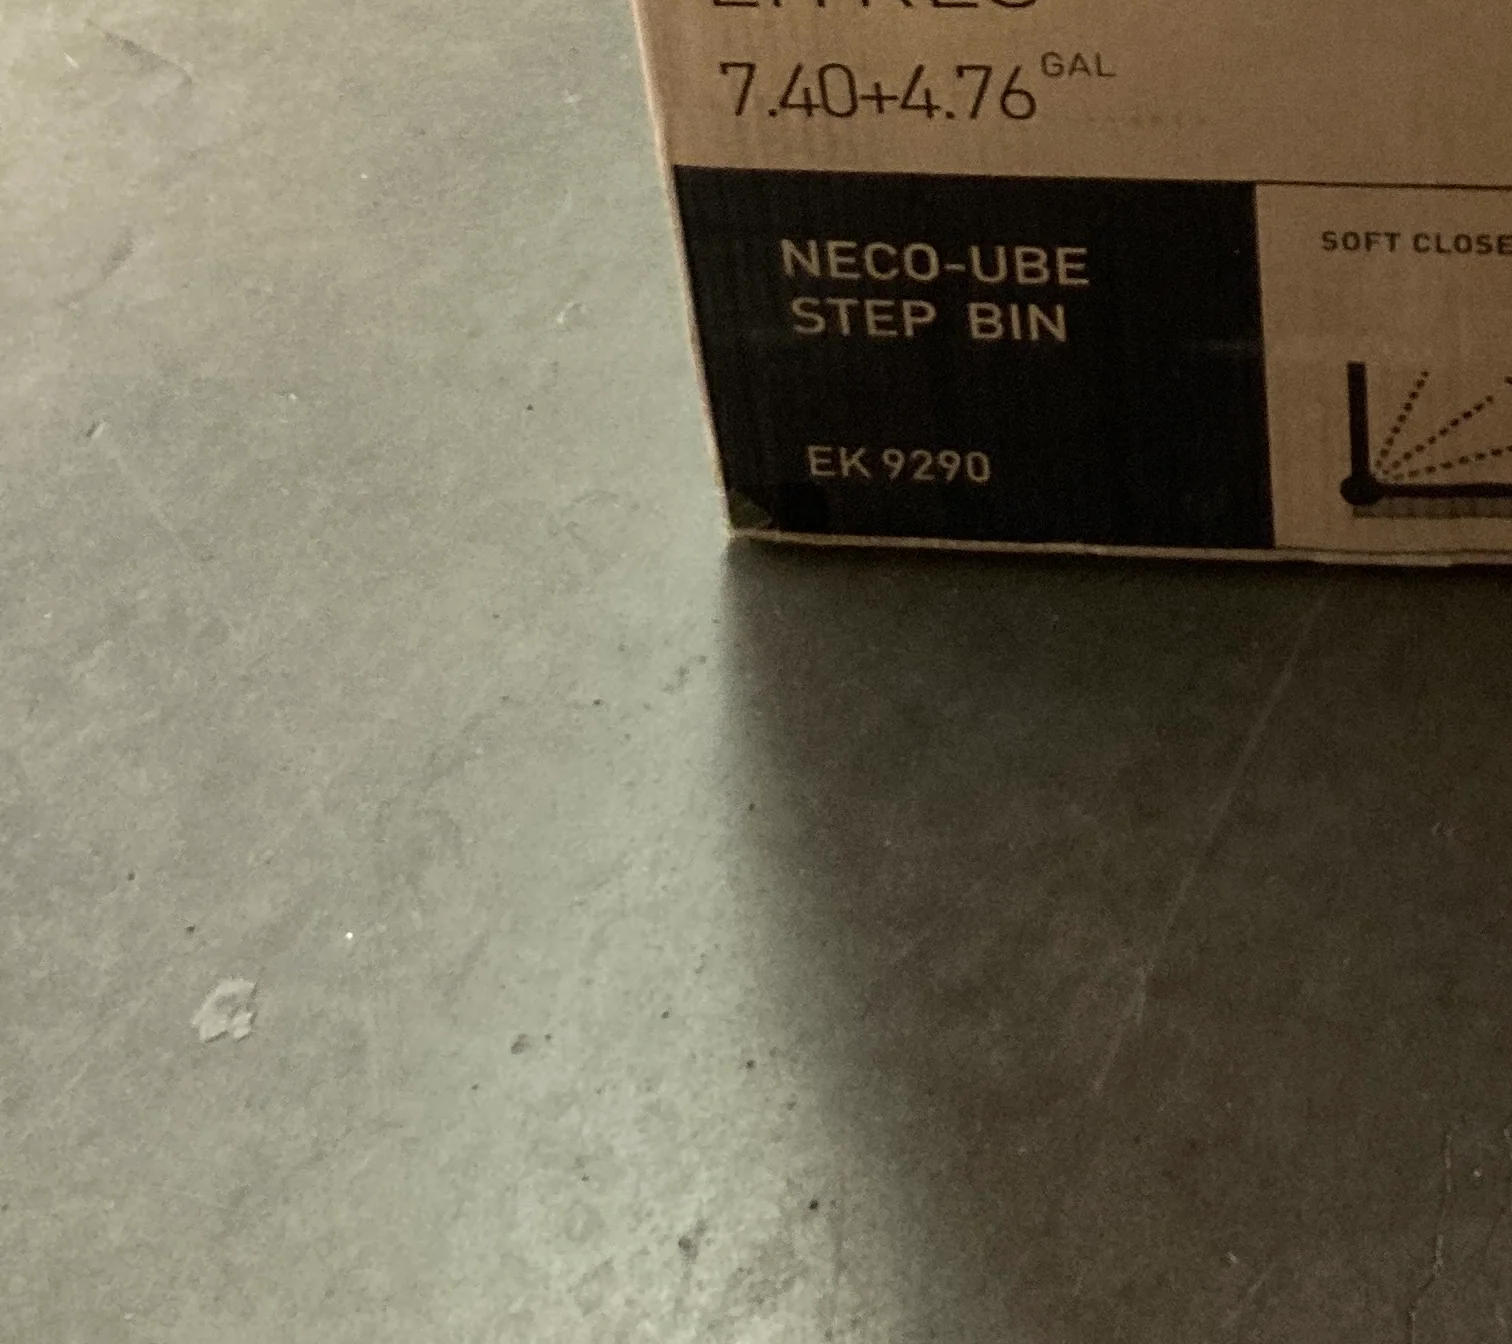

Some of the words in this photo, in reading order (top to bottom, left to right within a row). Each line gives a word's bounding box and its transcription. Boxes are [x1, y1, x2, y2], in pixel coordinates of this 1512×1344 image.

[719, 61, 1037, 121] 7.40+4.76
[1040, 50, 1117, 78] GAL
[780, 237, 1091, 287] NECO-UBE
[1321, 229, 1402, 254] SOFT
[790, 296, 937, 337] STEP
[968, 302, 1068, 344] BIN
[806, 445, 872, 480] EK
[882, 448, 991, 483] 9290
